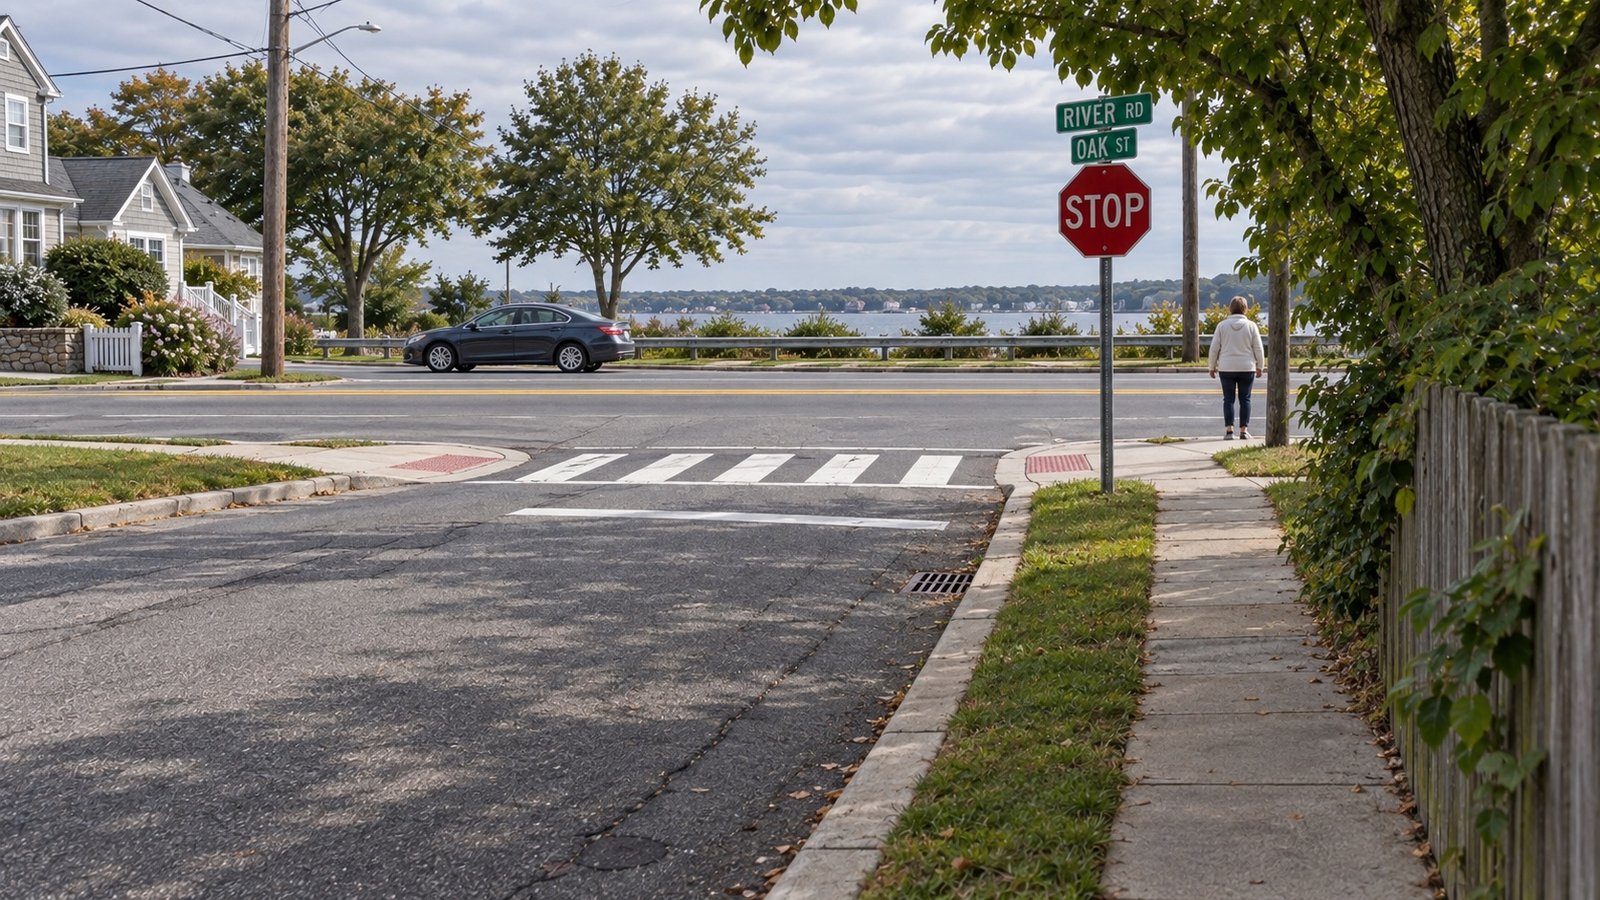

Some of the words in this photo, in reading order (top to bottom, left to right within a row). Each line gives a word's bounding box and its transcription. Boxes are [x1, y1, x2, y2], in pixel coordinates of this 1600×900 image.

[1063, 102, 1116, 128] RIVER
[1125, 101, 1144, 119] RD
[1076, 136, 1109, 160] OAK
[1115, 136, 1130, 153] ST
[1065, 192, 1145, 230] STOP
